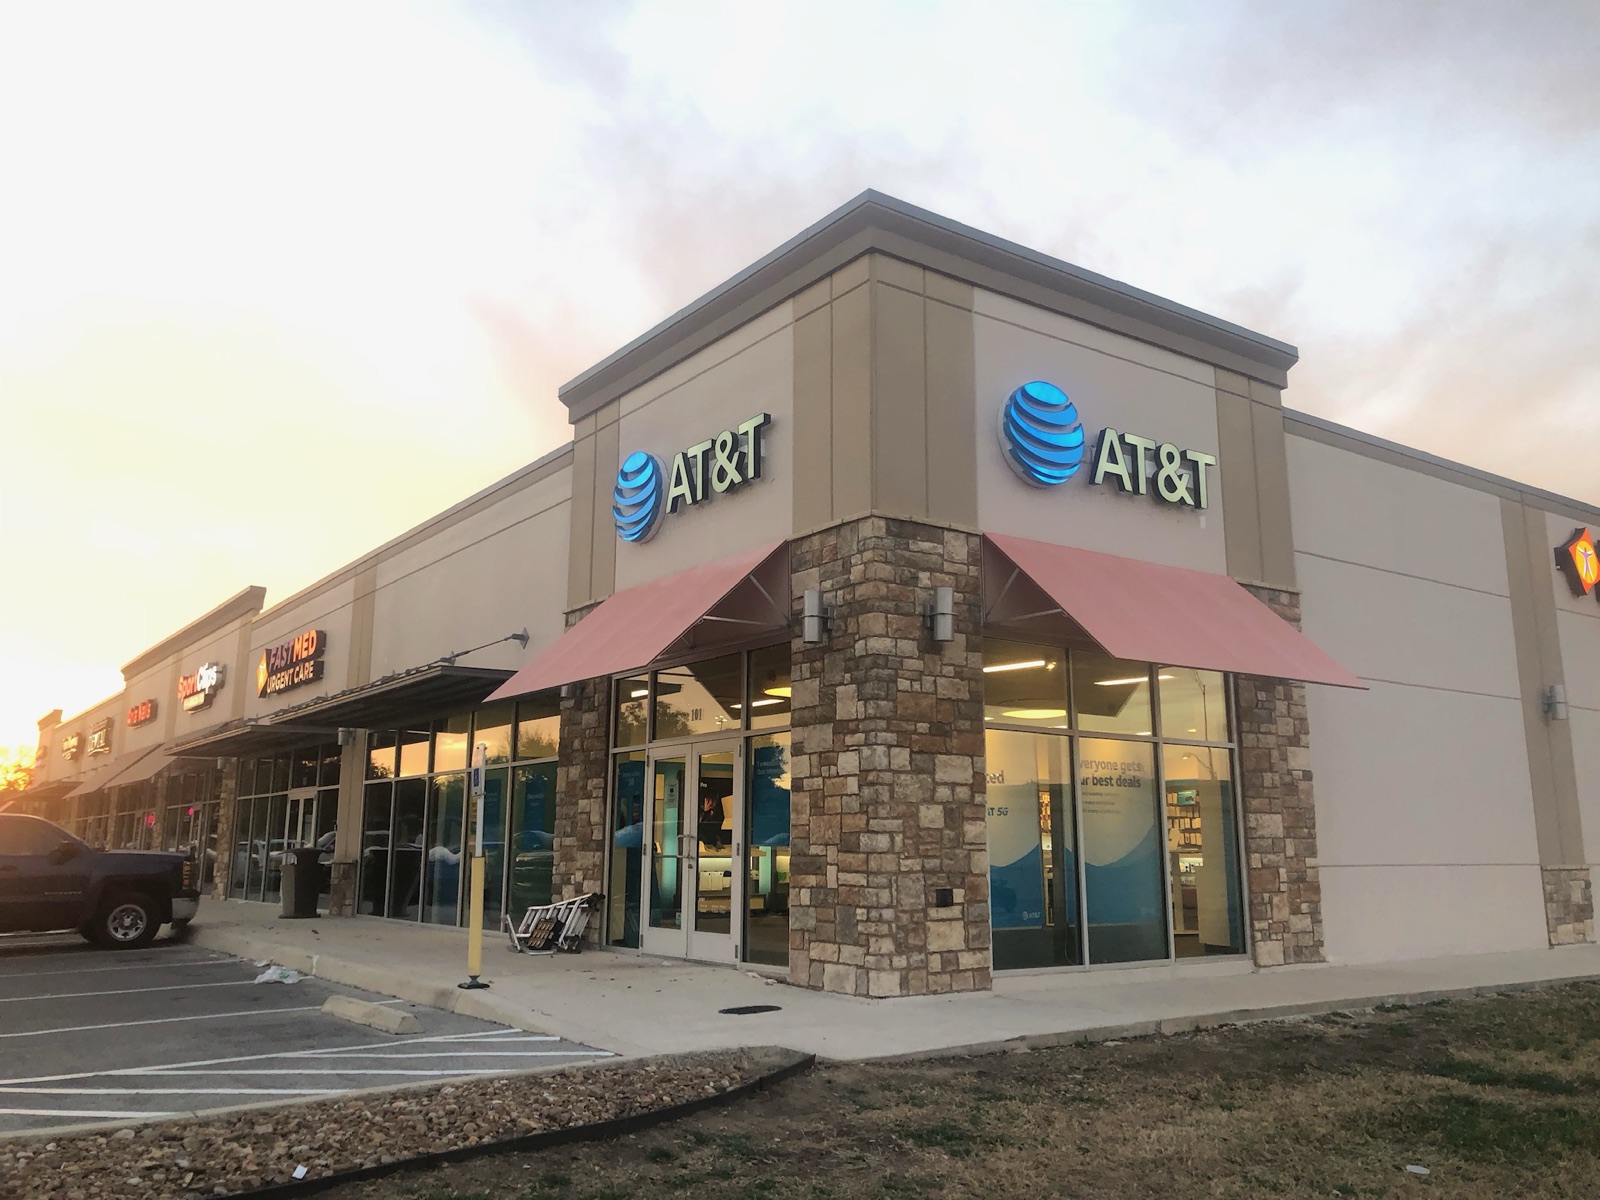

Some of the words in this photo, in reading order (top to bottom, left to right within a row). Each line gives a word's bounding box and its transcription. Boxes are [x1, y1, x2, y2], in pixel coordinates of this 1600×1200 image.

[666, 412, 769, 514] AT&T
[1091, 427, 1216, 509] AT&T
[269, 629, 317, 672] FASTMED
[267, 668, 294, 694] URGENT
[294, 661, 314, 684] CARE
[691, 708, 702, 721] 101
[1120, 761, 1142, 775] gets
[1092, 774, 1114, 787] best
[1116, 775, 1141, 788] deals
[997, 807, 1009, 816] 5G
